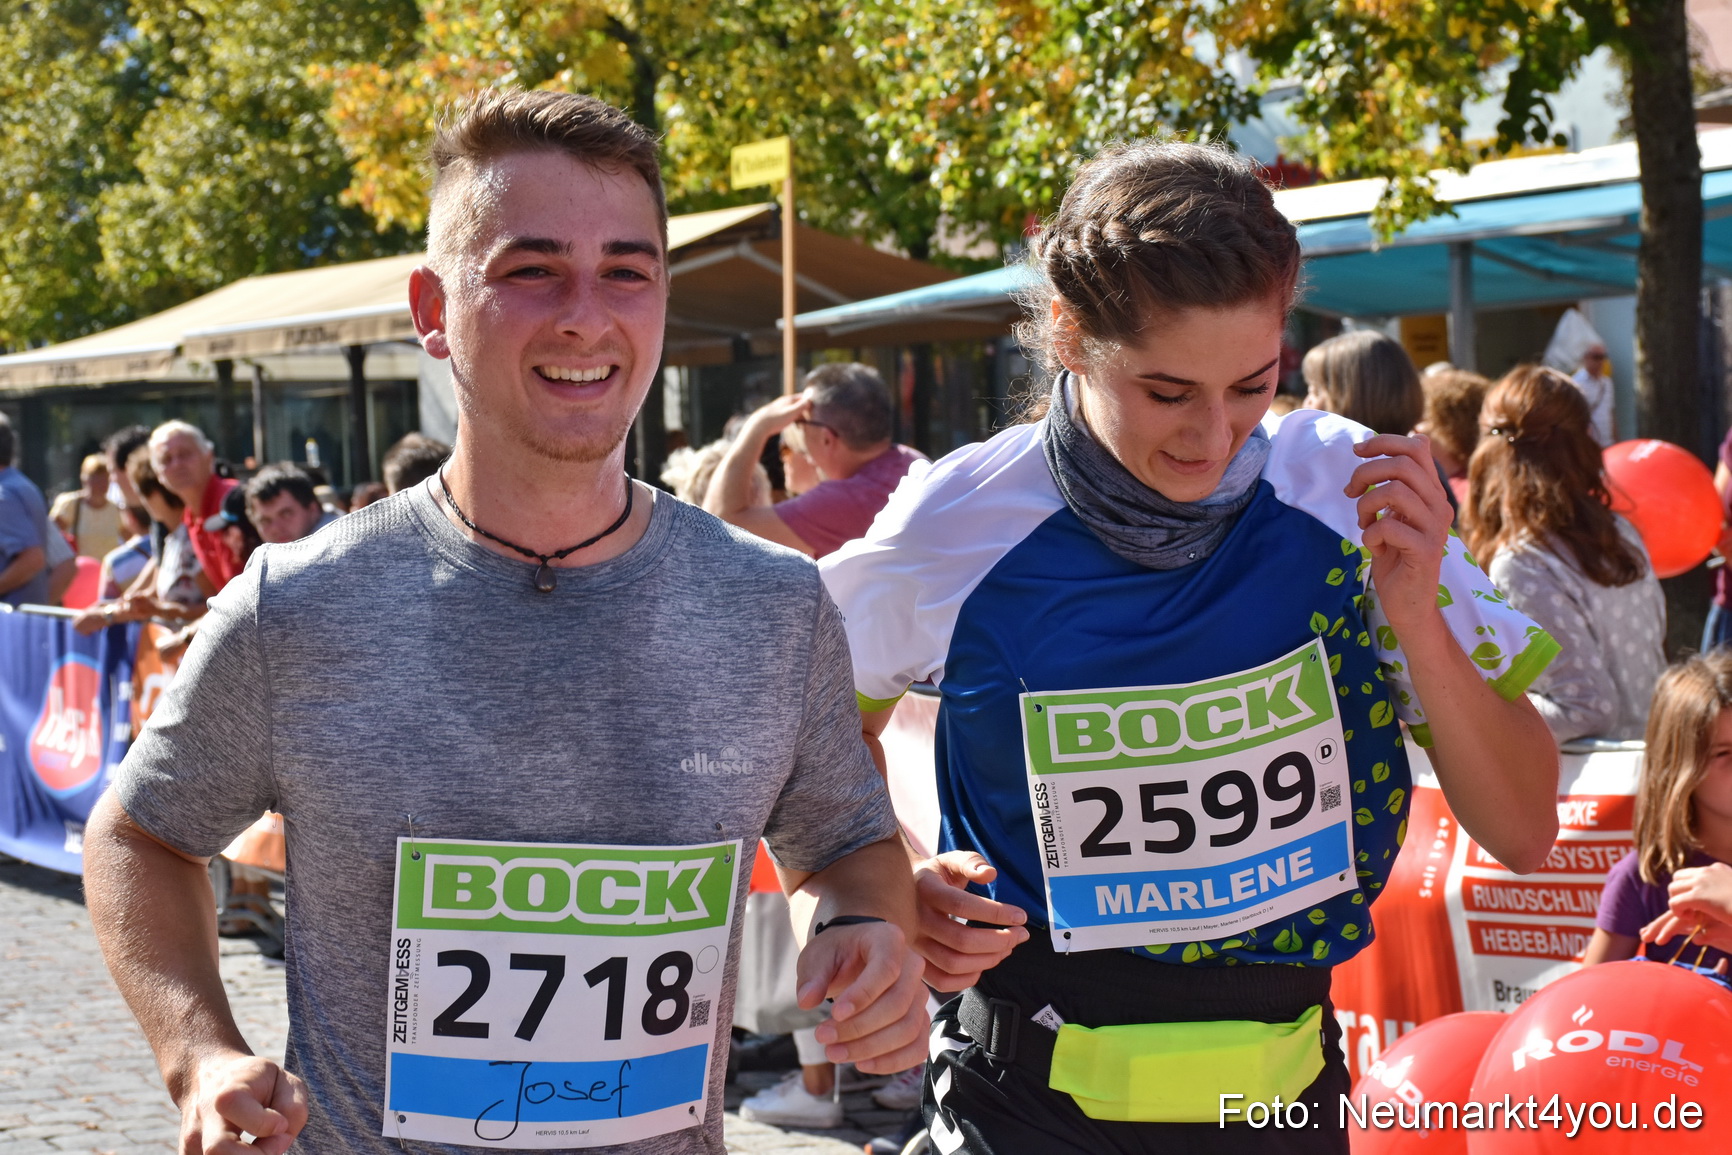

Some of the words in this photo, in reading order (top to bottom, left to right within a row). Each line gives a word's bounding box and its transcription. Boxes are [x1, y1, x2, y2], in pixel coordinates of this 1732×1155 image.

[1050, 666, 1311, 760] BOCK
[680, 752, 754, 776] ellesse
[1320, 744, 1332, 760] D
[1051, 781, 1061, 823] ZEITMESSUNG
[1071, 750, 1316, 859] 2599
[1058, 826, 1069, 868] TRANSPONDER
[1429, 817, 1449, 859] 1929
[426, 857, 710, 921] BOCK
[1095, 846, 1314, 916] MARLENE
[1472, 884, 1601, 914] RUNDSCHLIN
[1220, 919, 1239, 927] Marlene
[1241, 911, 1262, 922] Startblock
[414, 938, 422, 988] ZEITMESSUNG
[433, 949, 694, 1042] 2718
[1604, 1055, 1700, 1087] energie
[474, 1060, 632, 1141] Josef
